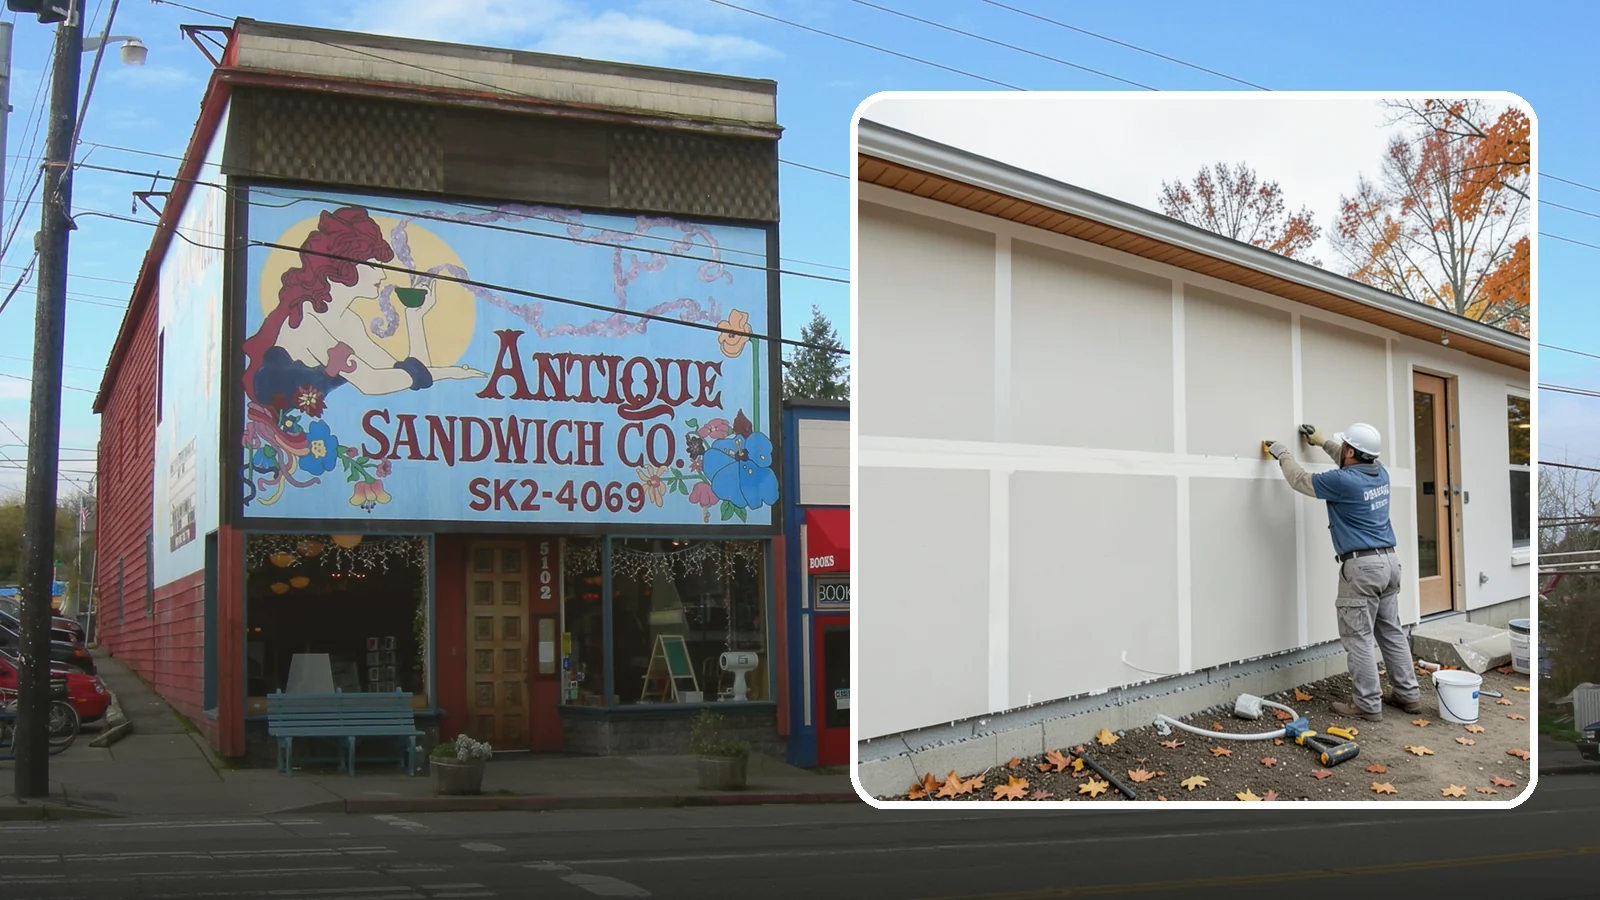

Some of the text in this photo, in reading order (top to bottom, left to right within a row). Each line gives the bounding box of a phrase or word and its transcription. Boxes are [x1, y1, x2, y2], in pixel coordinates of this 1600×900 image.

[476, 329, 724, 421] ANTIQUE
[361, 408, 686, 469] SANDWICH CO.
[468, 477, 646, 513] SK2-4069
[540, 541, 551, 600] 5102
[809, 555, 835, 569] BOOKS
